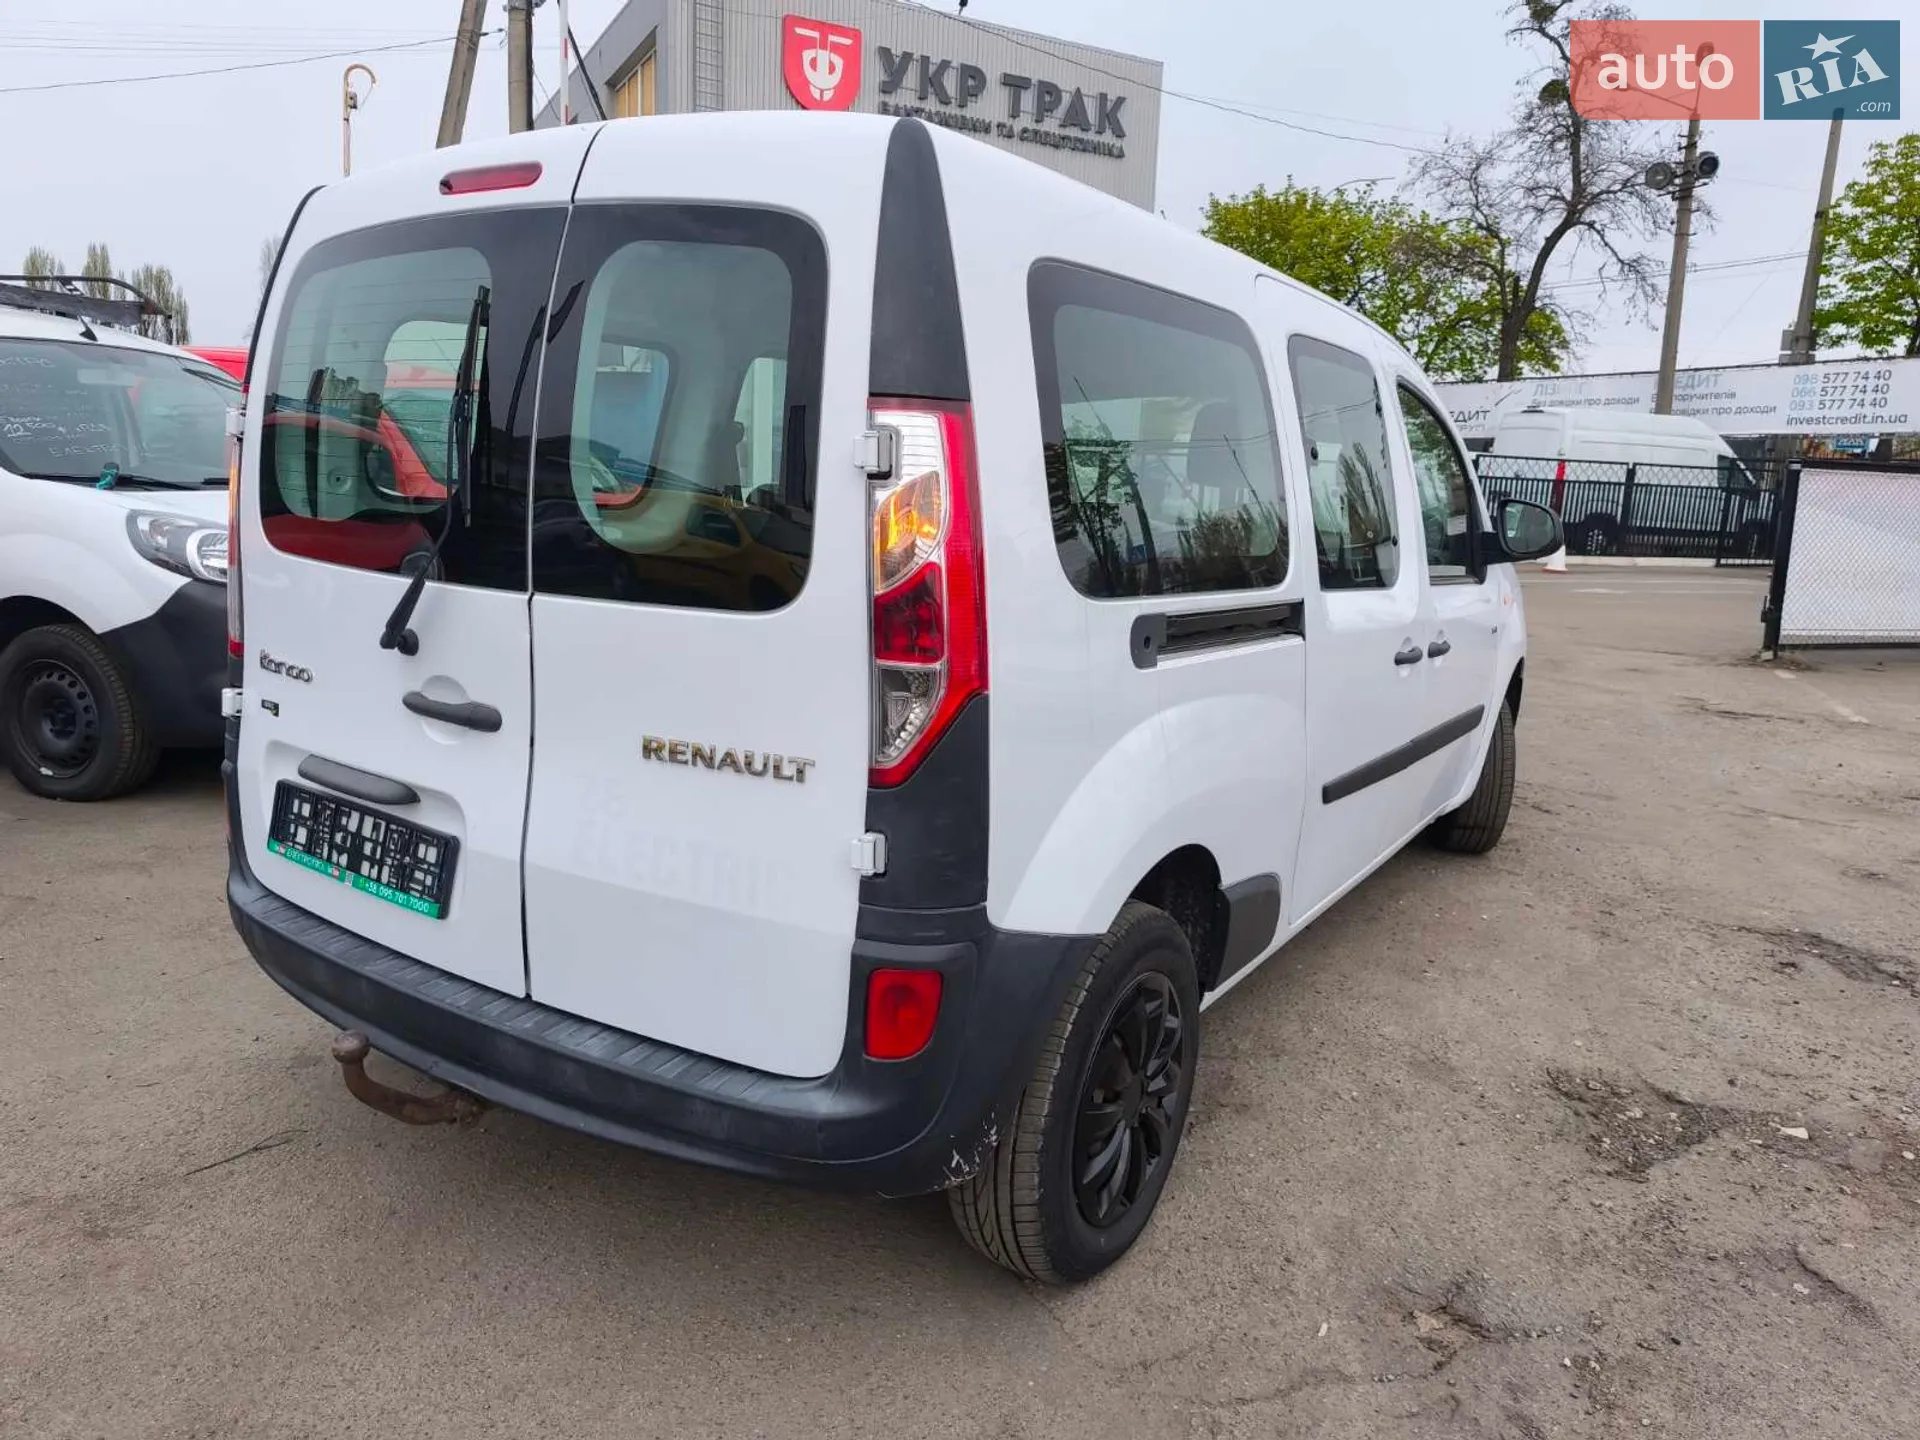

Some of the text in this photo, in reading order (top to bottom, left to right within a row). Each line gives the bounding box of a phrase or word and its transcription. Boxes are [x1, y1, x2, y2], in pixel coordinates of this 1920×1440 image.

[878, 46, 1128, 138] УКР ТРАК
[1822, 372, 1849, 384] 577
[1853, 371, 1870, 382] 74
[1874, 369, 1892, 381] 40
[1820, 385, 1847, 397] 577
[1851, 384, 1867, 396] 74
[1871, 383, 1890, 395] 40
[1818, 398, 1845, 410] 577
[1848, 398, 1865, 409] 74
[1869, 396, 1888, 408] 40
[1711, 406, 1732, 418] про
[1734, 405, 1777, 416] доходи
[1786, 413, 1908, 427] investcredit.in.ua
[641, 735, 815, 784] RENAULT
[380, 886, 393, 900] 095
